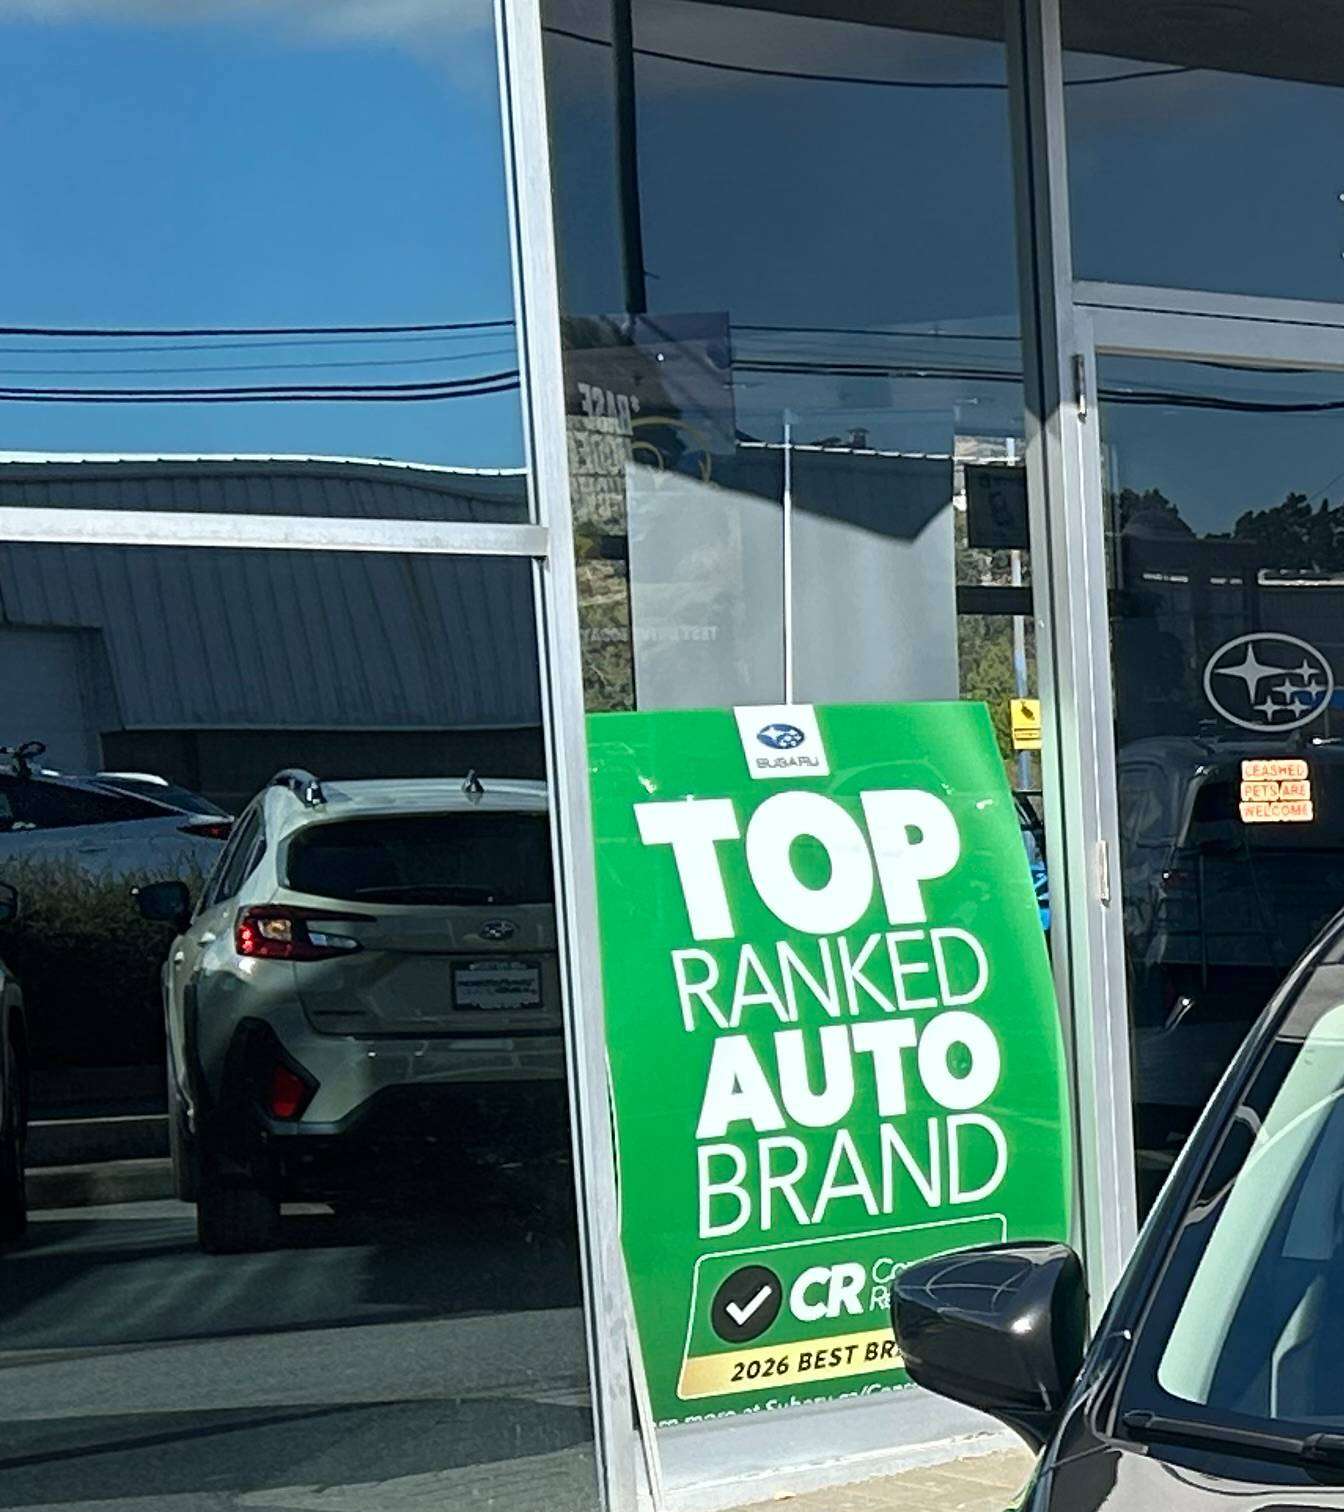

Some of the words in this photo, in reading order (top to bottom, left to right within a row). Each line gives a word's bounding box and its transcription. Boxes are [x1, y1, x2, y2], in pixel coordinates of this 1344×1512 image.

[755, 756, 820, 769] SUBARU
[1244, 804, 1309, 818] WELCOME
[634, 788, 961, 942] TOP
[671, 928, 989, 1032] RANKED
[695, 1009, 1001, 1140] AUTO
[697, 1113, 1009, 1240] BRAND
[789, 1261, 866, 1322] CR
[730, 1357, 790, 1383] 2026
[797, 1344, 859, 1373] BEST
